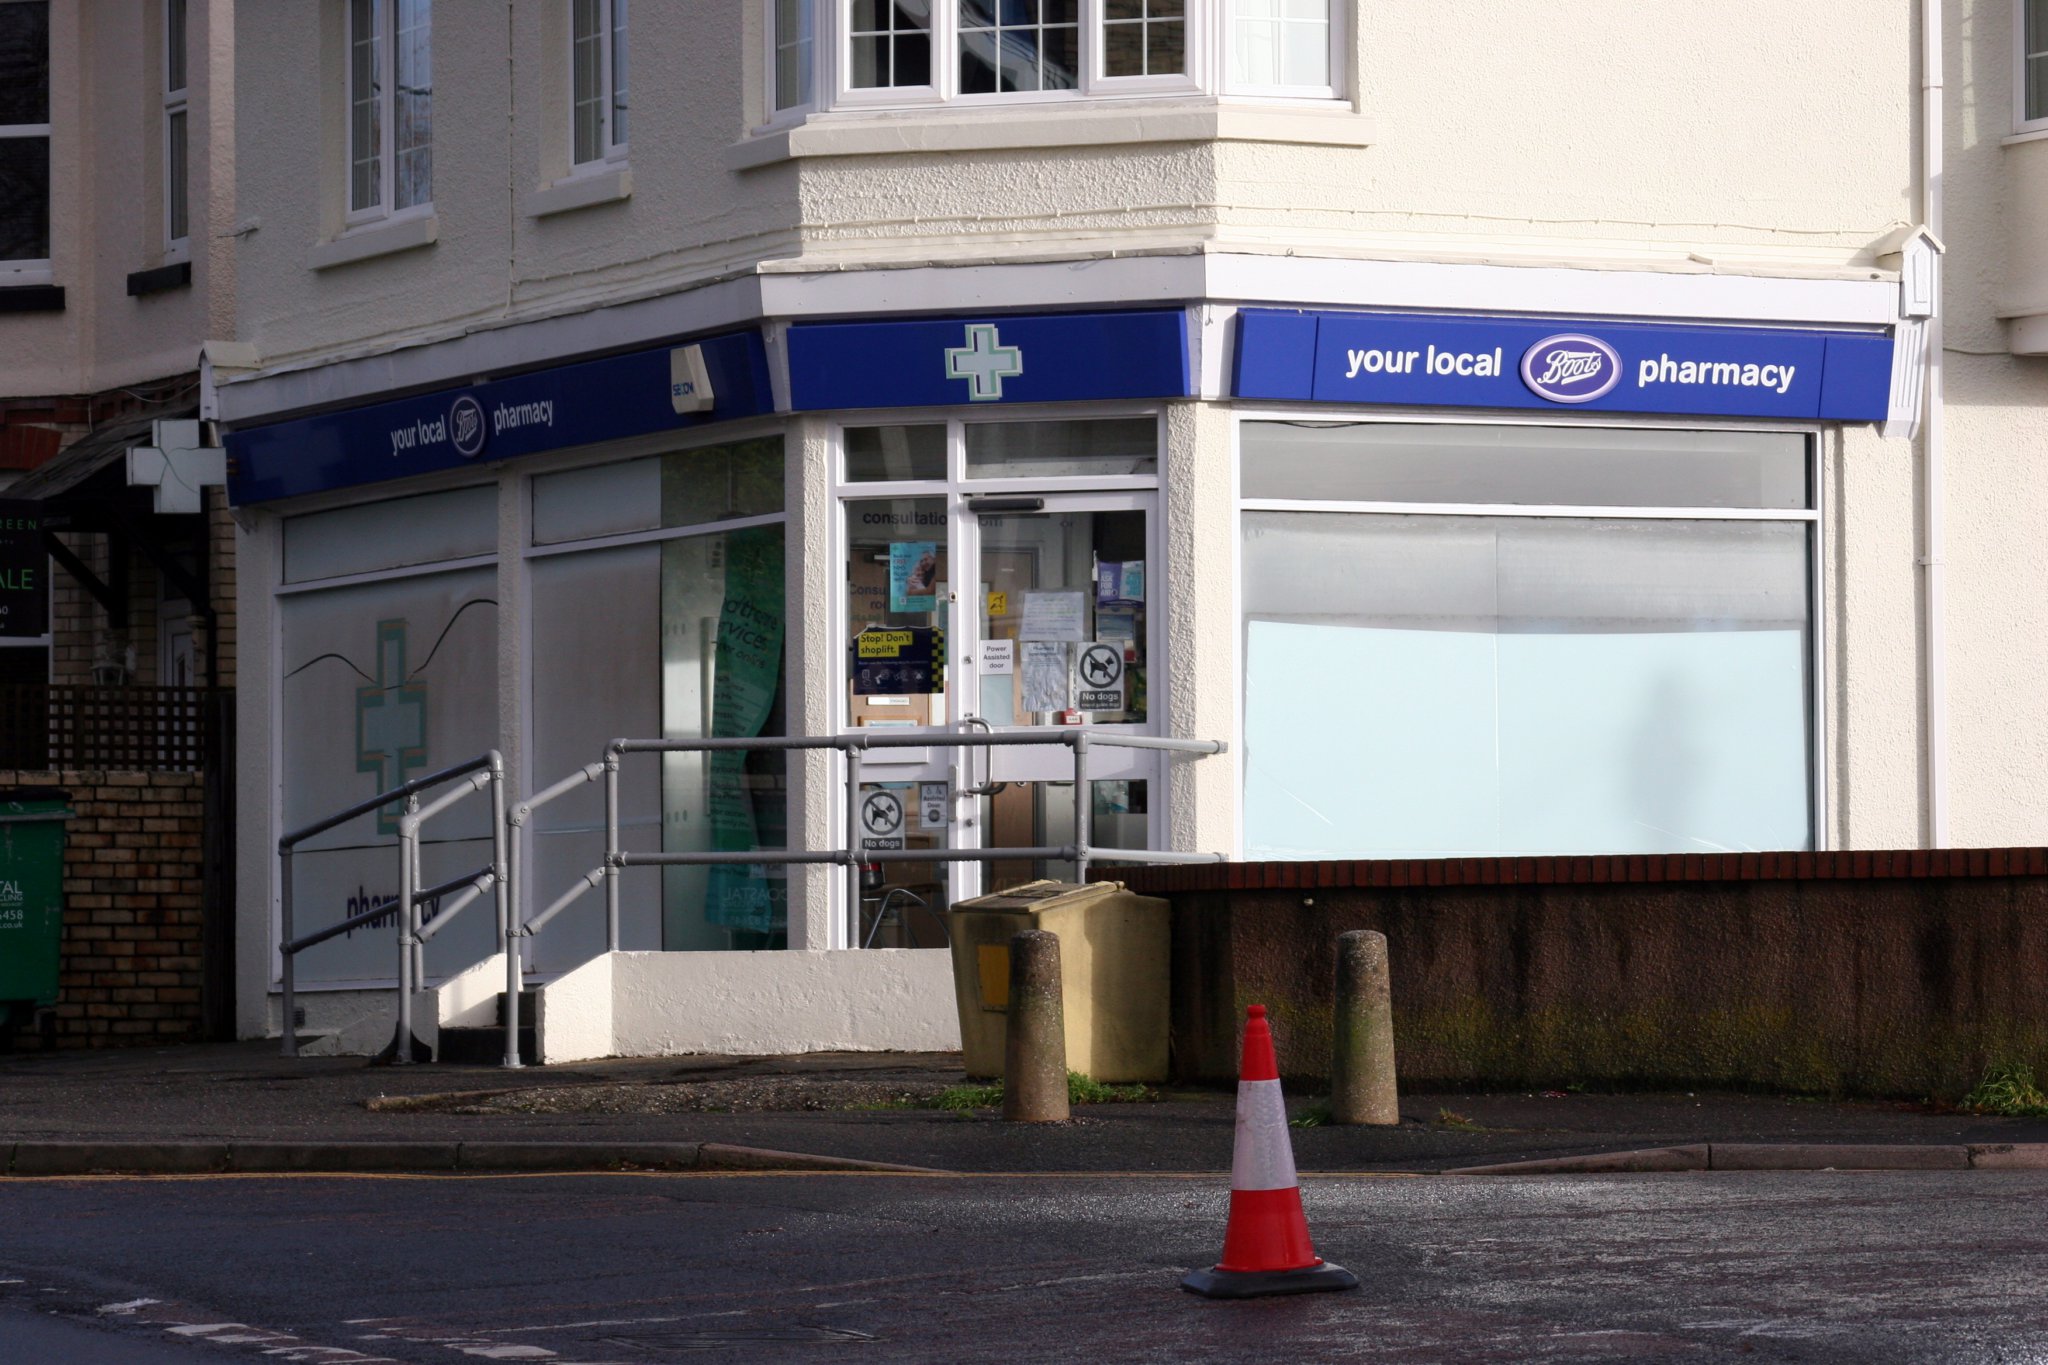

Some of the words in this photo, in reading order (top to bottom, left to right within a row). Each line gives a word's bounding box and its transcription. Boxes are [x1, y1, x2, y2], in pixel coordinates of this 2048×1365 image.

[1346, 348, 1419, 379] your
[1427, 345, 1502, 377] local
[1537, 350, 1602, 385] Boots
[1638, 353, 1796, 394] pharmacy
[391, 424, 416, 456] your
[417, 414, 446, 445] local
[493, 400, 553, 436] pharmacy
[863, 512, 948, 525] consultatio
[861, 633, 884, 644] Stop!
[886, 633, 910, 642] Don't
[861, 645, 896, 654] shoplift.
[1082, 692, 1095, 701] No
[1097, 692, 1119, 702] dogs
[864, 839, 877, 848] No
[879, 839, 901, 849] dogs
[0, 909, 23, 921] 458
